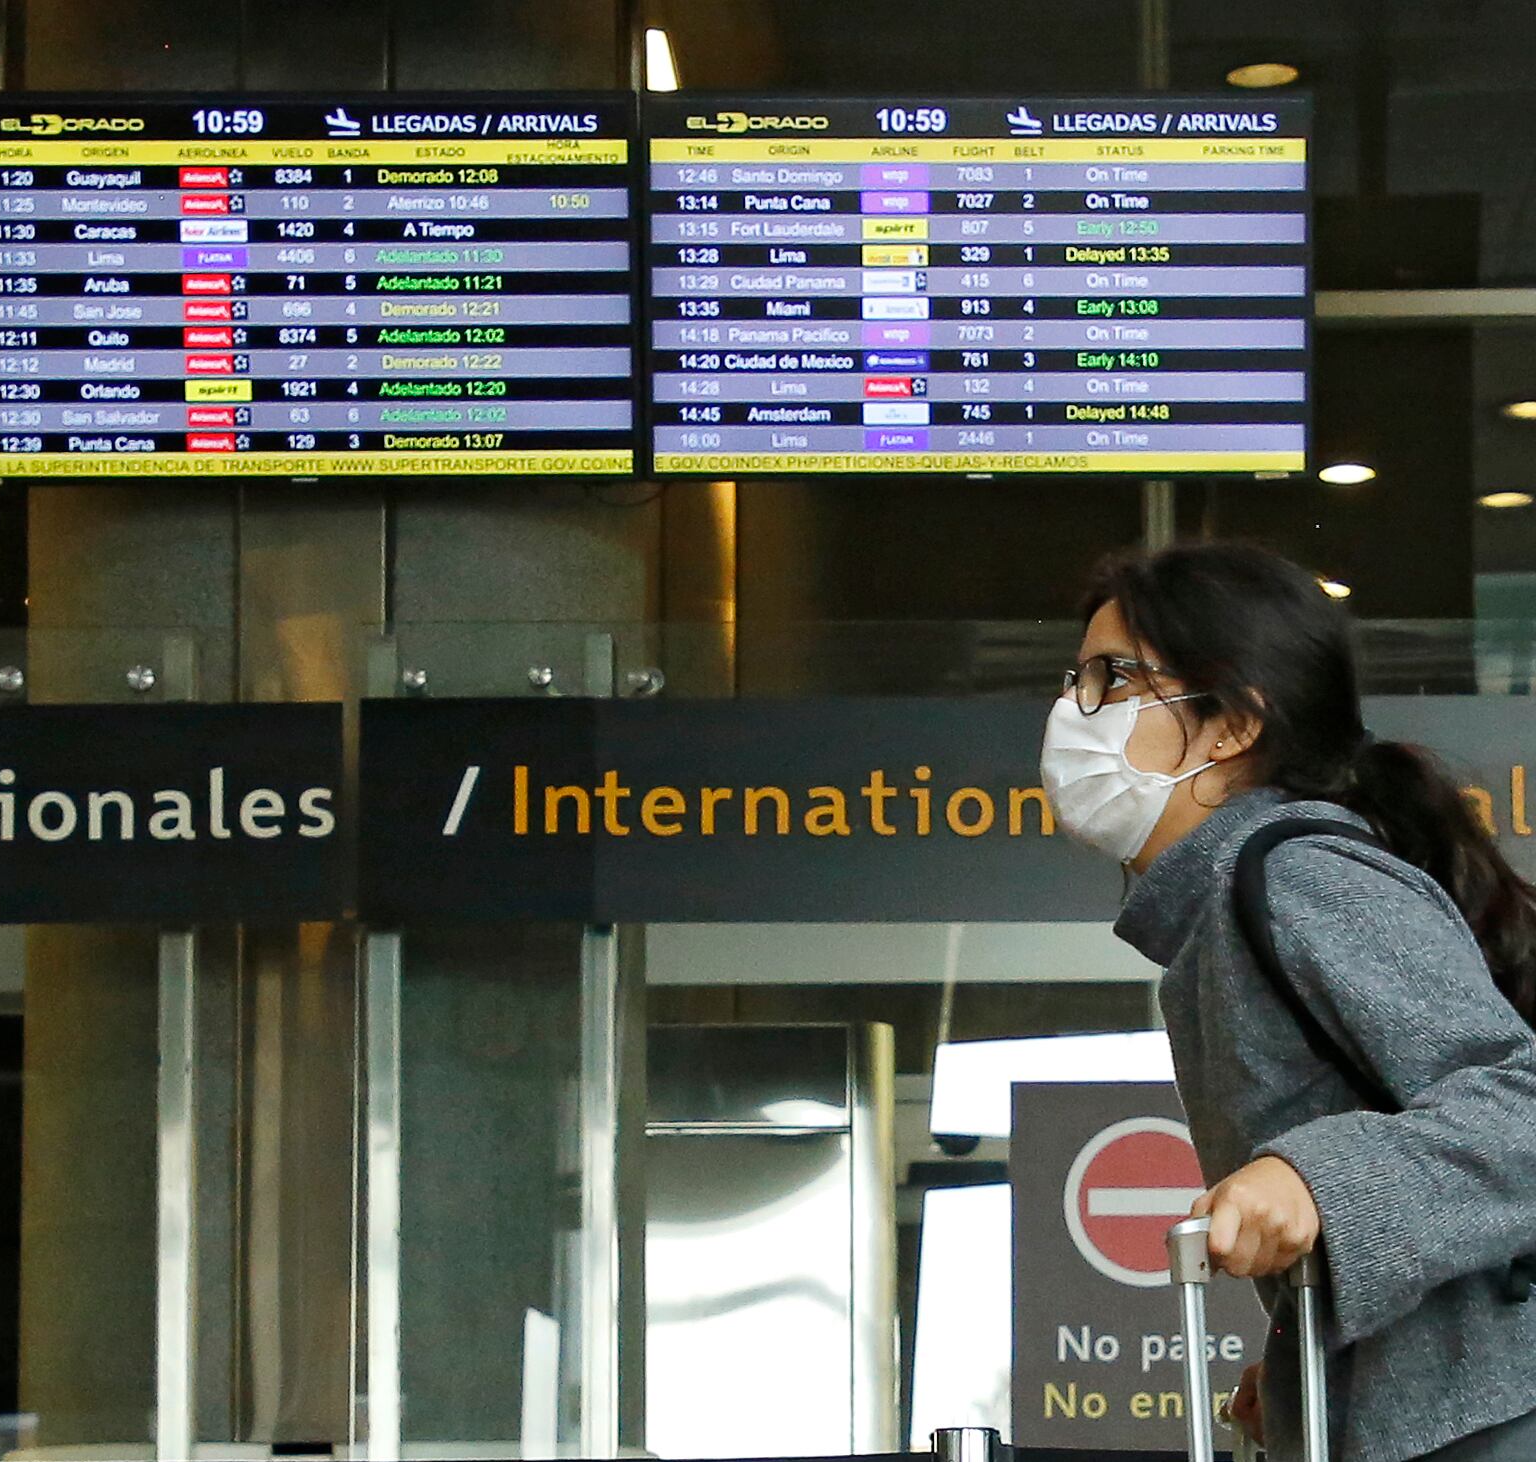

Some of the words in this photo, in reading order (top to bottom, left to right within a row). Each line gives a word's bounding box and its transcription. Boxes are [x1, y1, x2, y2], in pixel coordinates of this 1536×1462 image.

[193, 110, 263, 133] 10:59
[372, 115, 476, 132] LLEGADAS
[498, 115, 597, 132] ARRIVALS
[877, 109, 946, 131] 10:59
[1054, 114, 1157, 131] LLEGADAS
[1178, 114, 1277, 131] ARRIVALS
[272, 148, 313, 158] VUELO
[328, 148, 370, 158] BANDA
[416, 147, 465, 157] ESTADO
[688, 146, 713, 156] TIME
[768, 145, 810, 155] ORIGIN
[872, 146, 917, 156] AIRLINE
[953, 146, 995, 156] FLIGHT
[1014, 147, 1044, 157] BELT
[1097, 146, 1143, 156] STATUS
[65, 170, 143, 191] Guayaquil
[378, 169, 454, 183] Demorado
[677, 195, 718, 210] 13:14
[745, 195, 788, 210] Punta
[791, 195, 830, 210] Cana
[957, 193, 994, 208] 7027
[1086, 193, 1113, 209] On
[1115, 193, 1149, 209] Time
[74, 224, 136, 239] Caracas
[278, 222, 314, 237] 1420
[404, 222, 417, 236] A
[418, 222, 474, 240] Tiempo
[731, 221, 760, 237] Fort
[763, 221, 845, 237] Lauderdale
[875, 223, 915, 235] spirit
[678, 248, 719, 263] 13:28
[770, 248, 806, 263] Lima
[961, 246, 990, 261] 329
[1066, 247, 1125, 265] Delayed
[1129, 247, 1169, 261] 13:35
[84, 278, 129, 293] Aruba
[287, 275, 304, 290] 71
[377, 276, 459, 290] Adelantado
[463, 276, 501, 289] 11:21
[679, 301, 719, 316] 13:35
[767, 301, 810, 316] Miami
[962, 299, 990, 314] 913
[1078, 300, 1115, 317] Early
[89, 330, 129, 346] Quito
[279, 328, 316, 343] 8374
[378, 329, 460, 343] Adelantado
[465, 328, 504, 343] 12:02
[680, 354, 720, 369] 14:20
[725, 354, 779, 369] Ciudad
[782, 354, 799, 369] de
[803, 354, 854, 369] Mexico
[1078, 353, 1115, 370] Early
[1119, 353, 1158, 367] 14:10
[0, 384, 40, 399] 12:30
[81, 384, 140, 399] Orlando
[282, 381, 316, 396] 1921
[379, 382, 461, 396] Adelantado
[466, 381, 506, 395] 12:20
[680, 407, 720, 422] 14:45
[748, 407, 831, 422] Amsterdam
[962, 405, 991, 420] 745
[1067, 405, 1125, 423] Delayed
[1130, 405, 1169, 419] 14:48
[67, 437, 112, 452] Punta
[115, 437, 156, 452] Cana
[384, 435, 459, 448] Demorado
[464, 434, 503, 448] 13:07
[7, 460, 26, 473] LA
[31, 459, 189, 473] SUPERINTENDENCIA
[194, 459, 215, 472] DE
[222, 458, 326, 472] TRANSPORTE
[442, 766, 479, 836] /
[513, 765, 1056, 836] Internation
[1057, 1325, 1121, 1363] No
[1043, 1382, 1109, 1420] No
